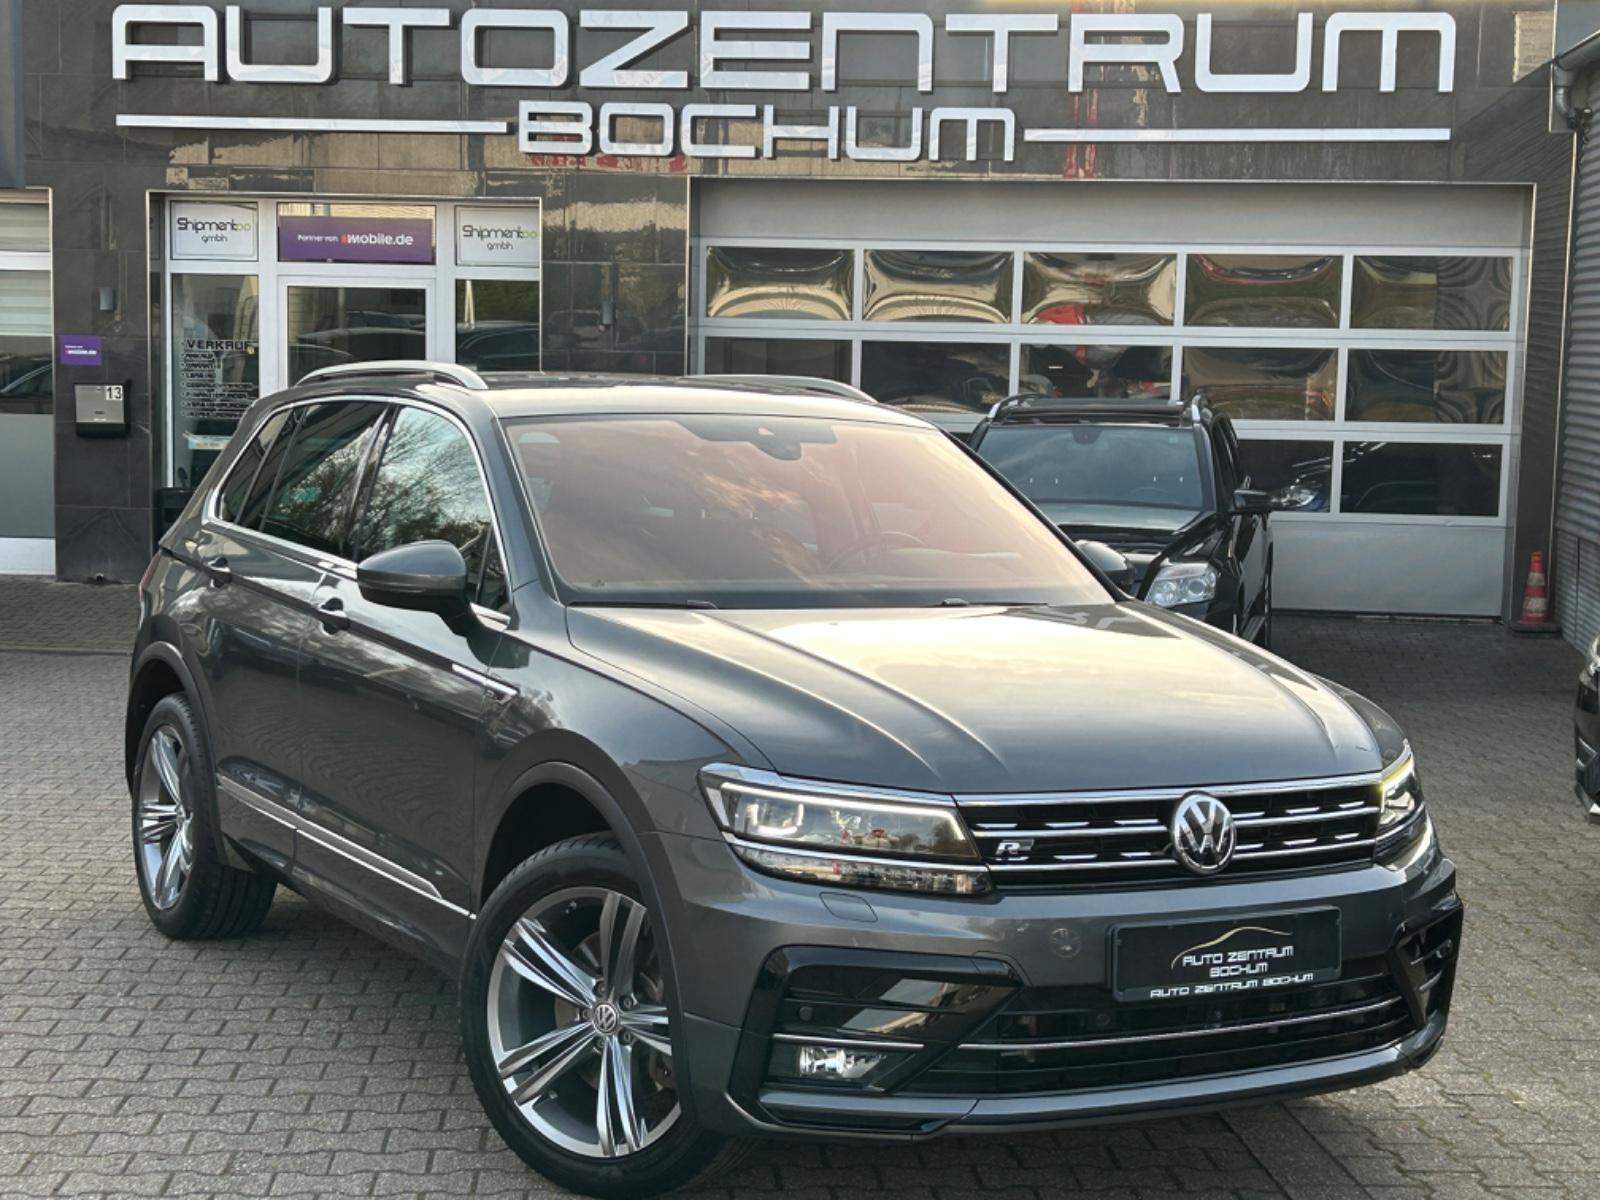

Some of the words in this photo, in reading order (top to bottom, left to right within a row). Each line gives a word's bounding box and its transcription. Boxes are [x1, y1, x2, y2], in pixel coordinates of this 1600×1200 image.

[111, 4, 1456, 93] AUTOZENTRUM
[519, 100, 1015, 162] BOCHUM
[106, 386, 122, 399] 13
[1182, 951, 1224, 967] AUTO
[1227, 945, 1294, 963] ZENTRUM
[1209, 962, 1268, 978] BOCHUM
[1150, 986, 1190, 999] AUTO
[1194, 980, 1258, 993] ZENTRUM
[1262, 973, 1314, 986] BOCHUM
